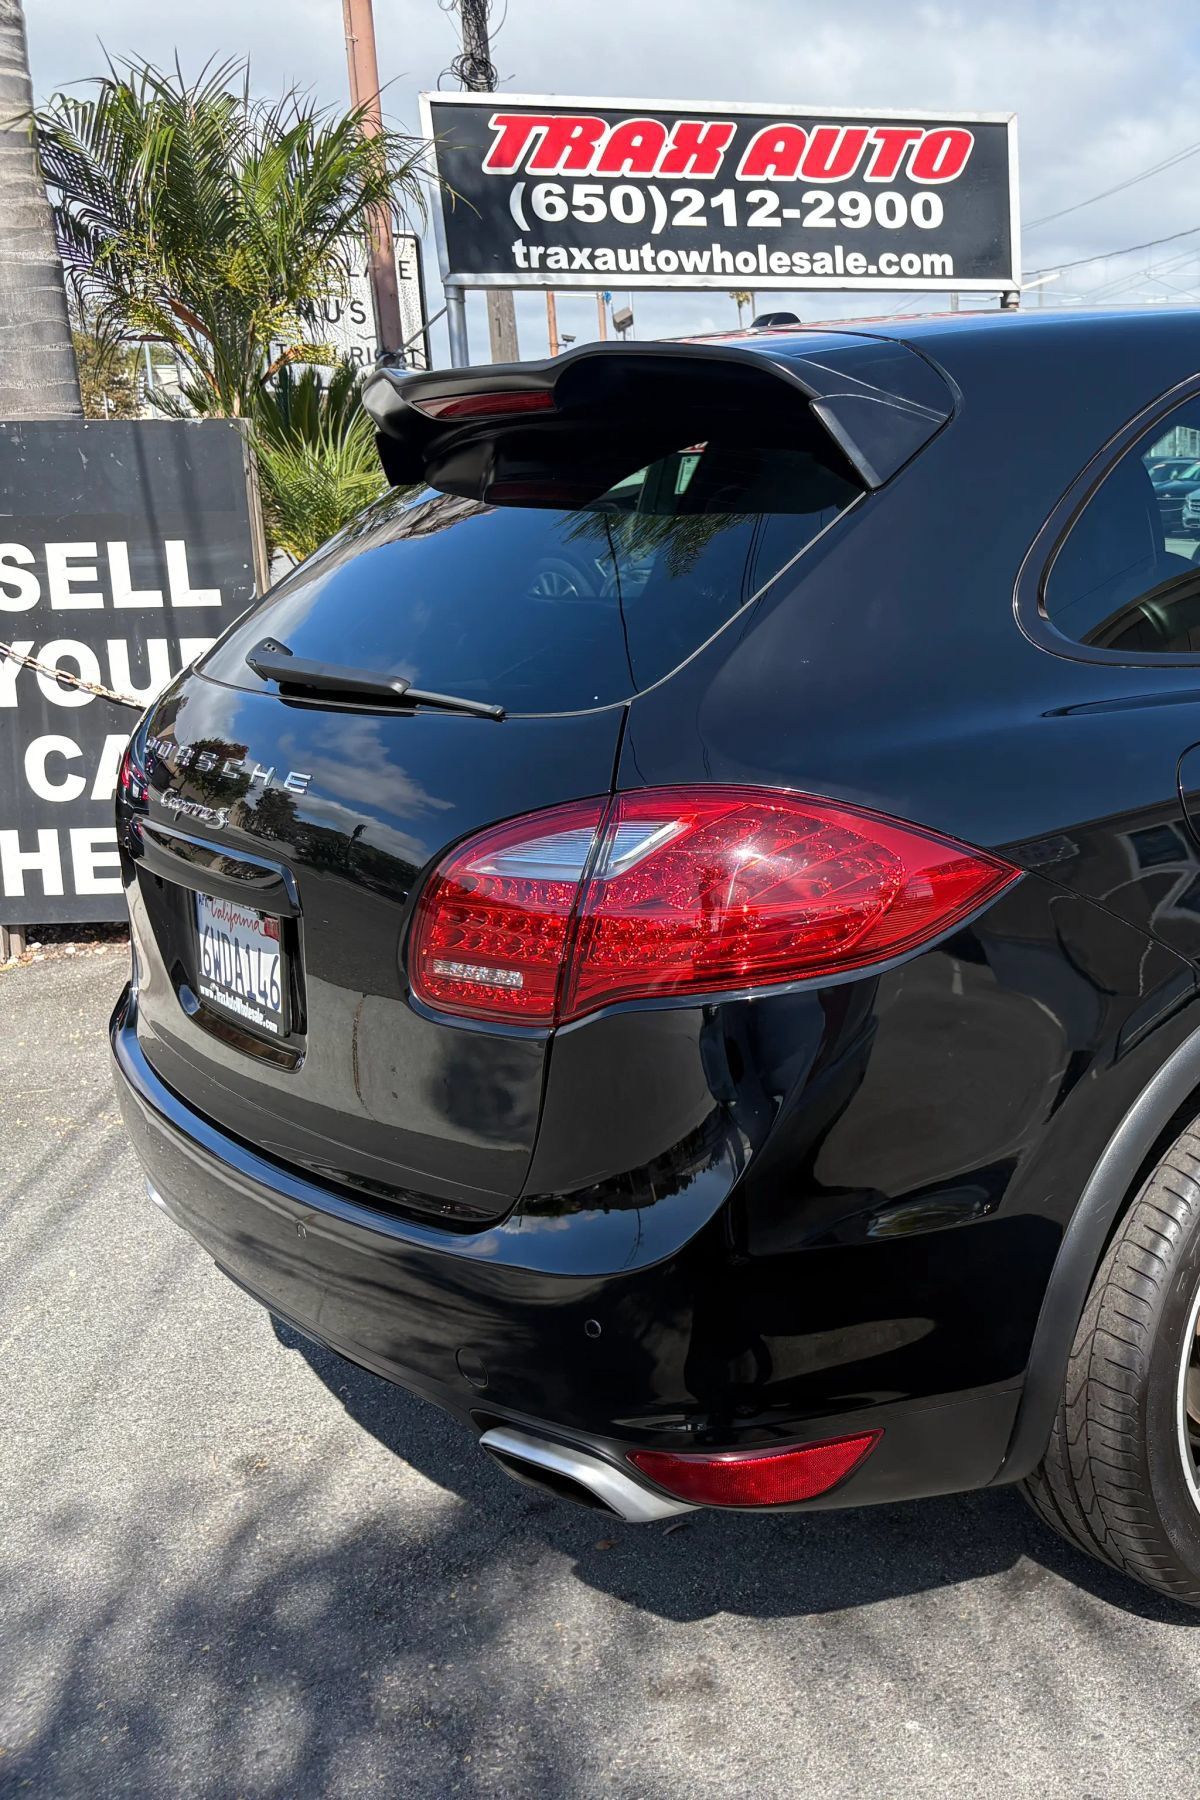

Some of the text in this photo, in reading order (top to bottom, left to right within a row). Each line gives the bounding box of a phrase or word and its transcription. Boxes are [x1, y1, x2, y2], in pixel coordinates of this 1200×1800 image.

[482, 113, 973, 184] TRAX AUTO
[509, 182, 944, 234] (650)212-2900
[511, 238, 954, 276] traxautowholesale.com
[0, 540, 222, 612] SELL
[0, 638, 217, 708] YOU
[144, 736, 314, 795] PORSCHE
[210, 899, 264, 936] California
[202, 925, 280, 1011] 6WDA146
